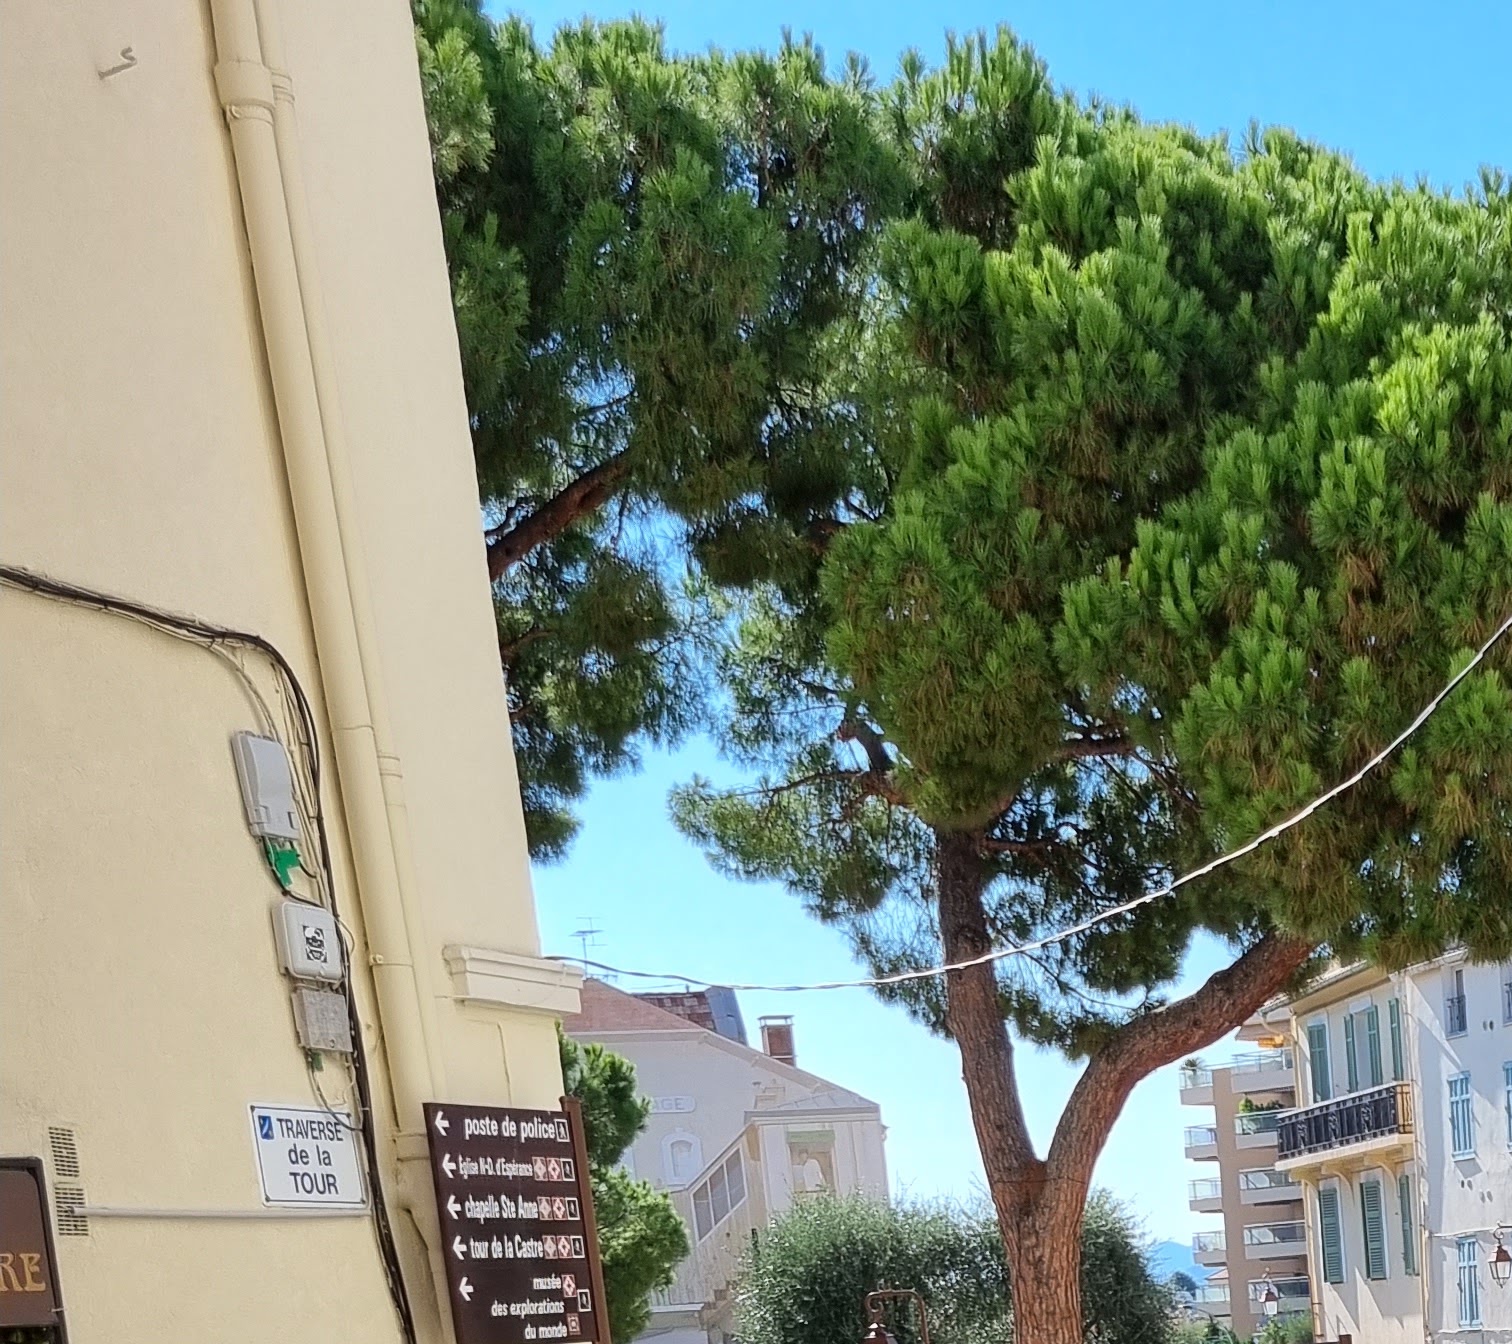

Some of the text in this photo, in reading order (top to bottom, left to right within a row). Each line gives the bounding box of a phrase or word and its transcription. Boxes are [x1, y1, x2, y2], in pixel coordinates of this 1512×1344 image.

[276, 1117, 344, 1142] TRAVERSE
[464, 1115, 556, 1143] poste de police
[288, 1143, 332, 1167] de la
[289, 1172, 339, 1195] TOUR
[465, 1193, 539, 1224] chapelle Ste Anne
[470, 1234, 544, 1259] tour de la Castre
[533, 1274, 562, 1290] musée
[491, 1298, 565, 1319] des explorations
[524, 1321, 568, 1339] du monde
